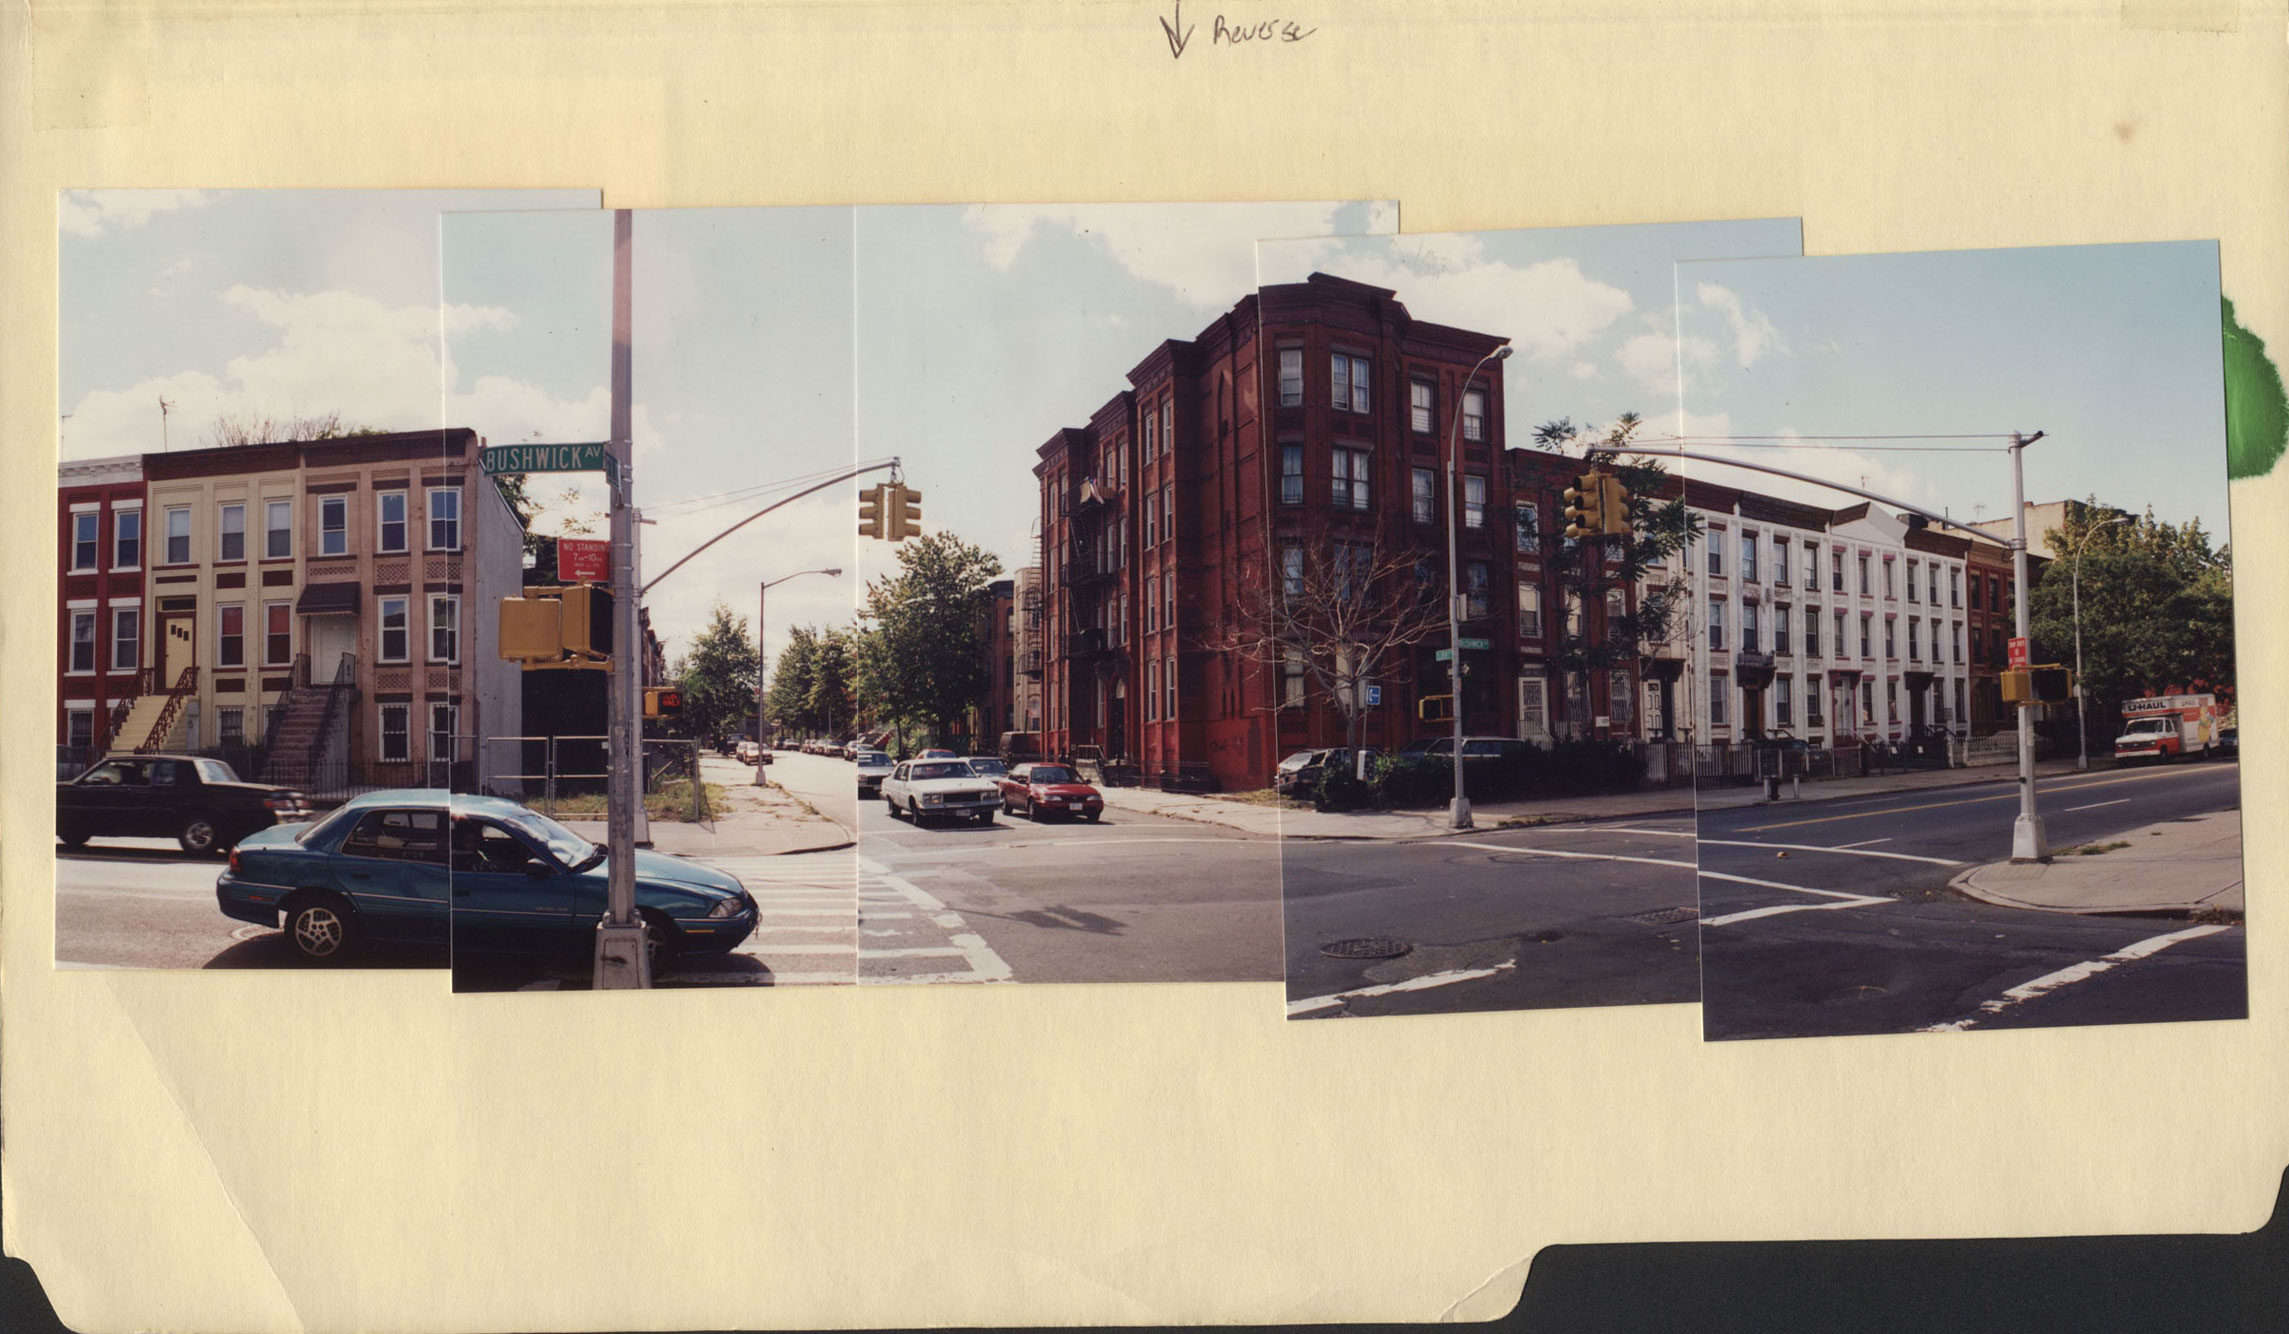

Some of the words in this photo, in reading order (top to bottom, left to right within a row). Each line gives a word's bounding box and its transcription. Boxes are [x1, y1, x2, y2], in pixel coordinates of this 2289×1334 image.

[1213, 14, 1318, 46] Reverse
[486, 447, 582, 472] BUSHWICK
[584, 446, 601, 459] AV
[563, 543, 573, 551] NO
[2128, 701, 2167, 712] U-HAUL
